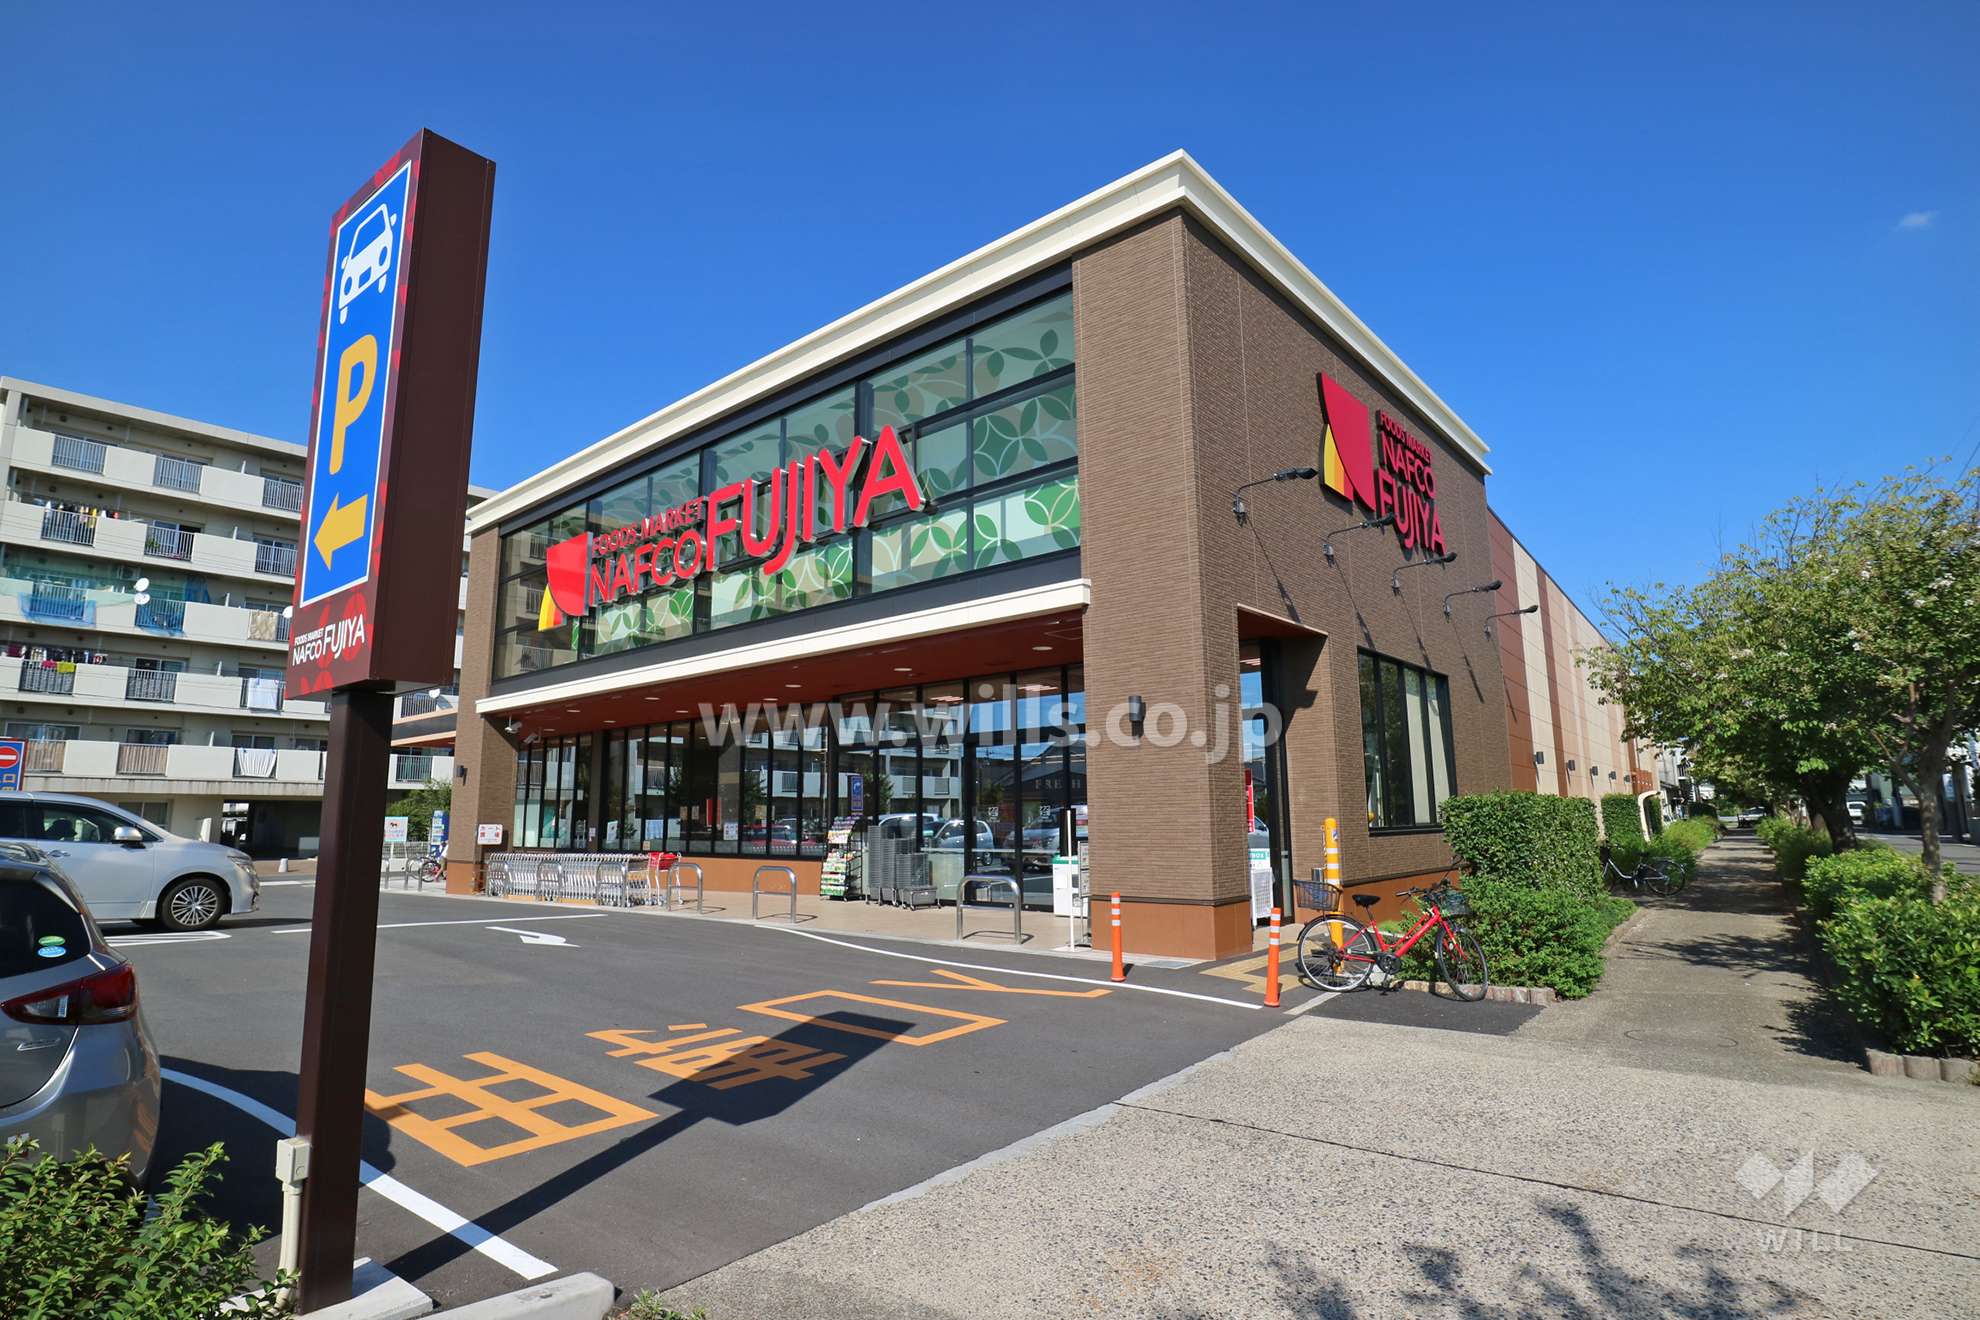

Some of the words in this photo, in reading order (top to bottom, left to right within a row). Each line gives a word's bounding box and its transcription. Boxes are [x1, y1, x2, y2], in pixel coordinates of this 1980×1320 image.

[329, 334, 378, 475] P
[1381, 431, 1436, 498] NAFCO
[588, 529, 702, 607] NAFCO
[705, 424, 925, 575] FUJIYA
[591, 523, 638, 558] FOODS
[641, 496, 704, 541] MARKET
[1378, 467, 1446, 557] FUJIYA
[292, 639, 322, 666] NAFCO
[322, 613, 365, 659] FUJIYA
